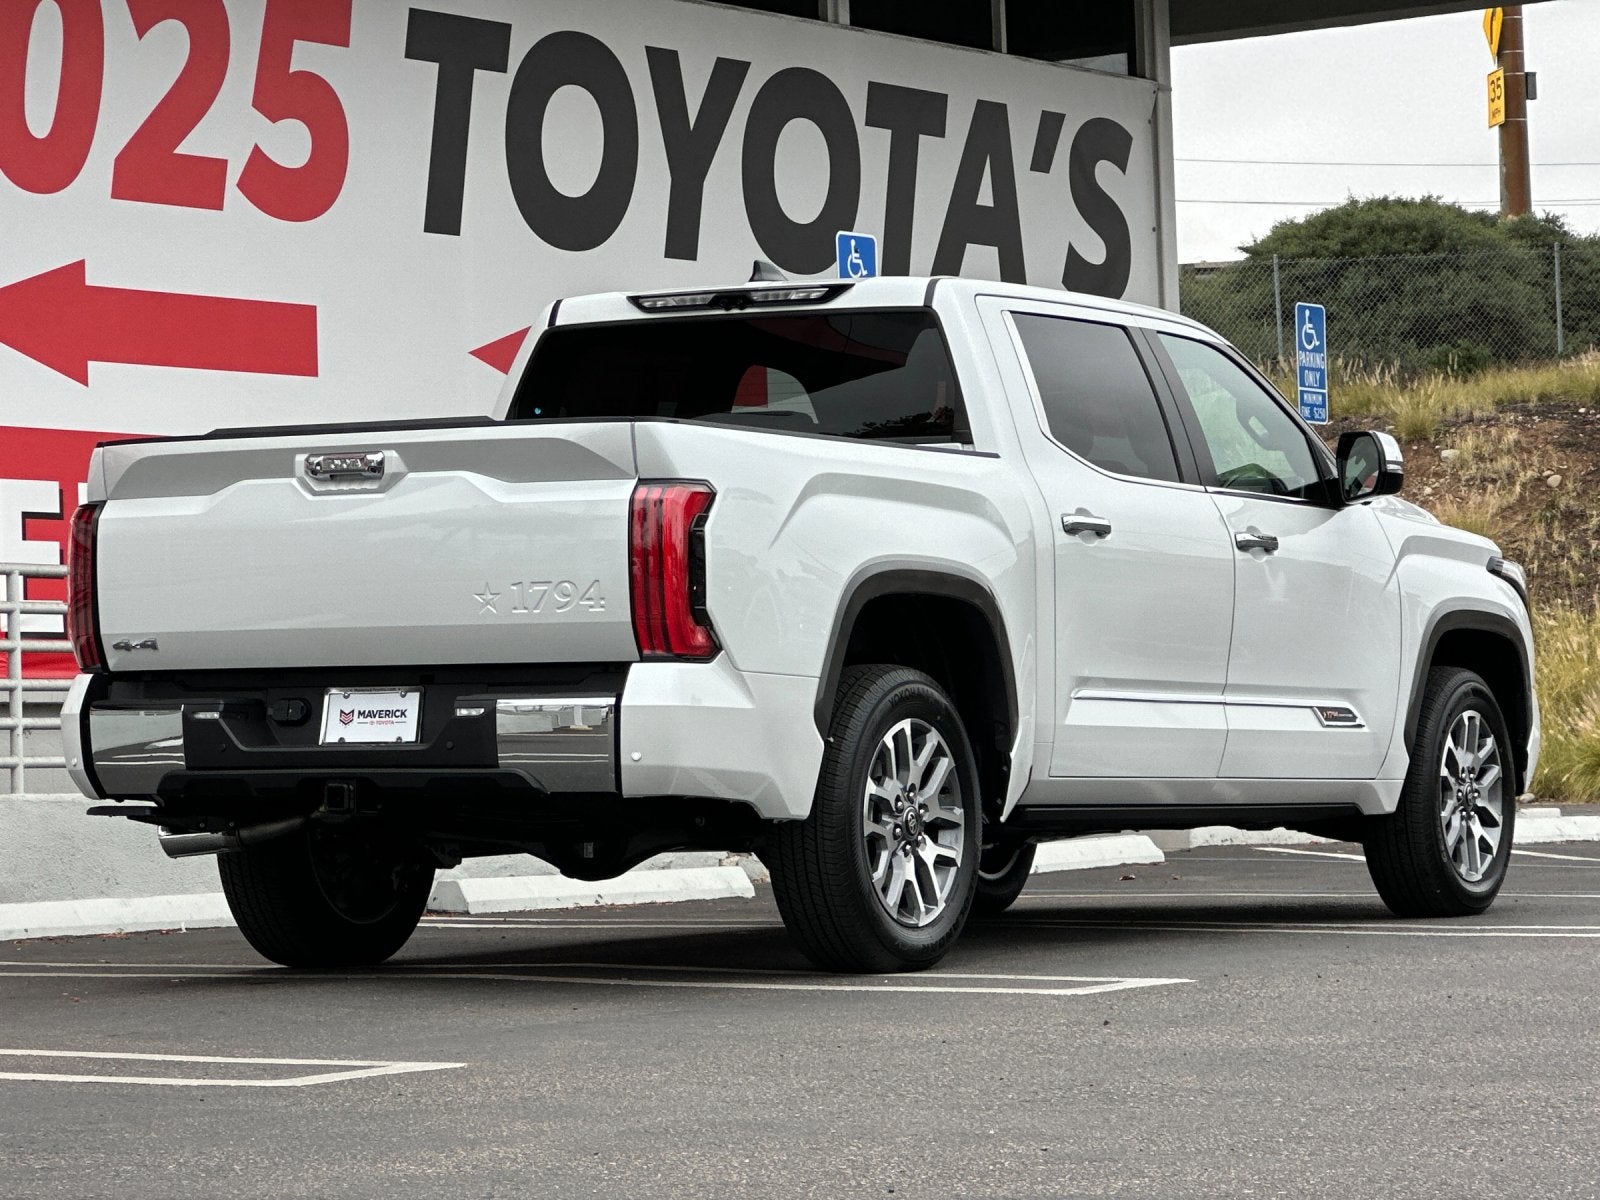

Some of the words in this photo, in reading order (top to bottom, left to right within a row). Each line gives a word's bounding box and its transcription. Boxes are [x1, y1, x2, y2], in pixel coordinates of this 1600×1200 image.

[1490, 76, 1503, 103] 35
[404, 8, 1133, 300] TOYOTA'S
[1299, 351, 1325, 369] PARKING
[1304, 370, 1321, 387] ONLY
[510, 580, 606, 613] 1794
[357, 709, 408, 719] MAVERICK
